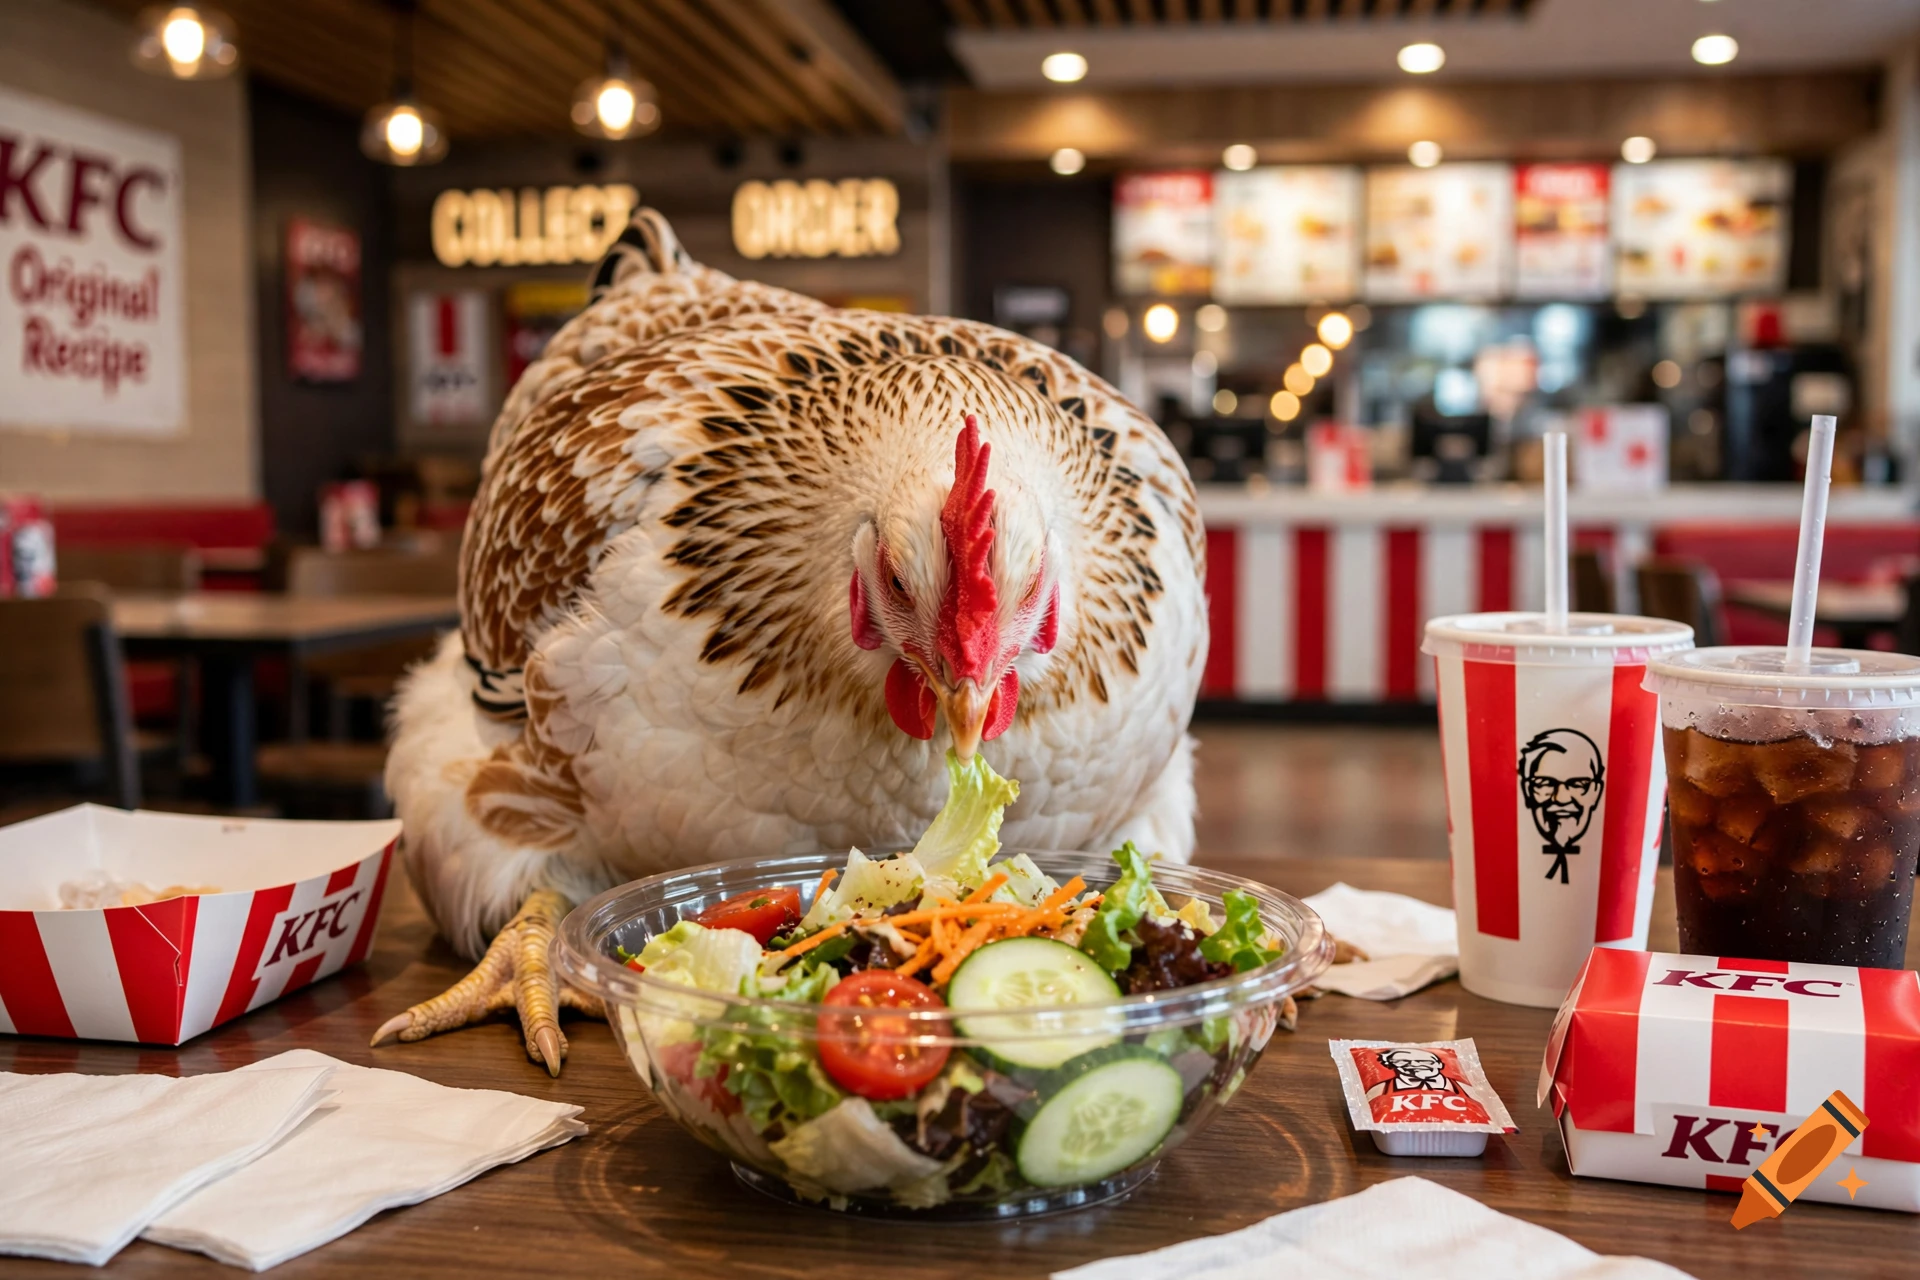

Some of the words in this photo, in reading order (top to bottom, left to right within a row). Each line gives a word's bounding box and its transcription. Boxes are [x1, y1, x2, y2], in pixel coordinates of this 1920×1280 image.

[0, 134, 167, 255] KFC
[431, 184, 640, 268] COLLECT
[731, 177, 901, 260] ORDER
[9, 245, 160, 328] Original
[23, 315, 149, 394] Recipe
[263, 890, 361, 968] KFC
[1652, 969, 1843, 998] KFC
[1390, 1093, 1467, 1112] KFC
[1661, 1114, 1798, 1166] KF
